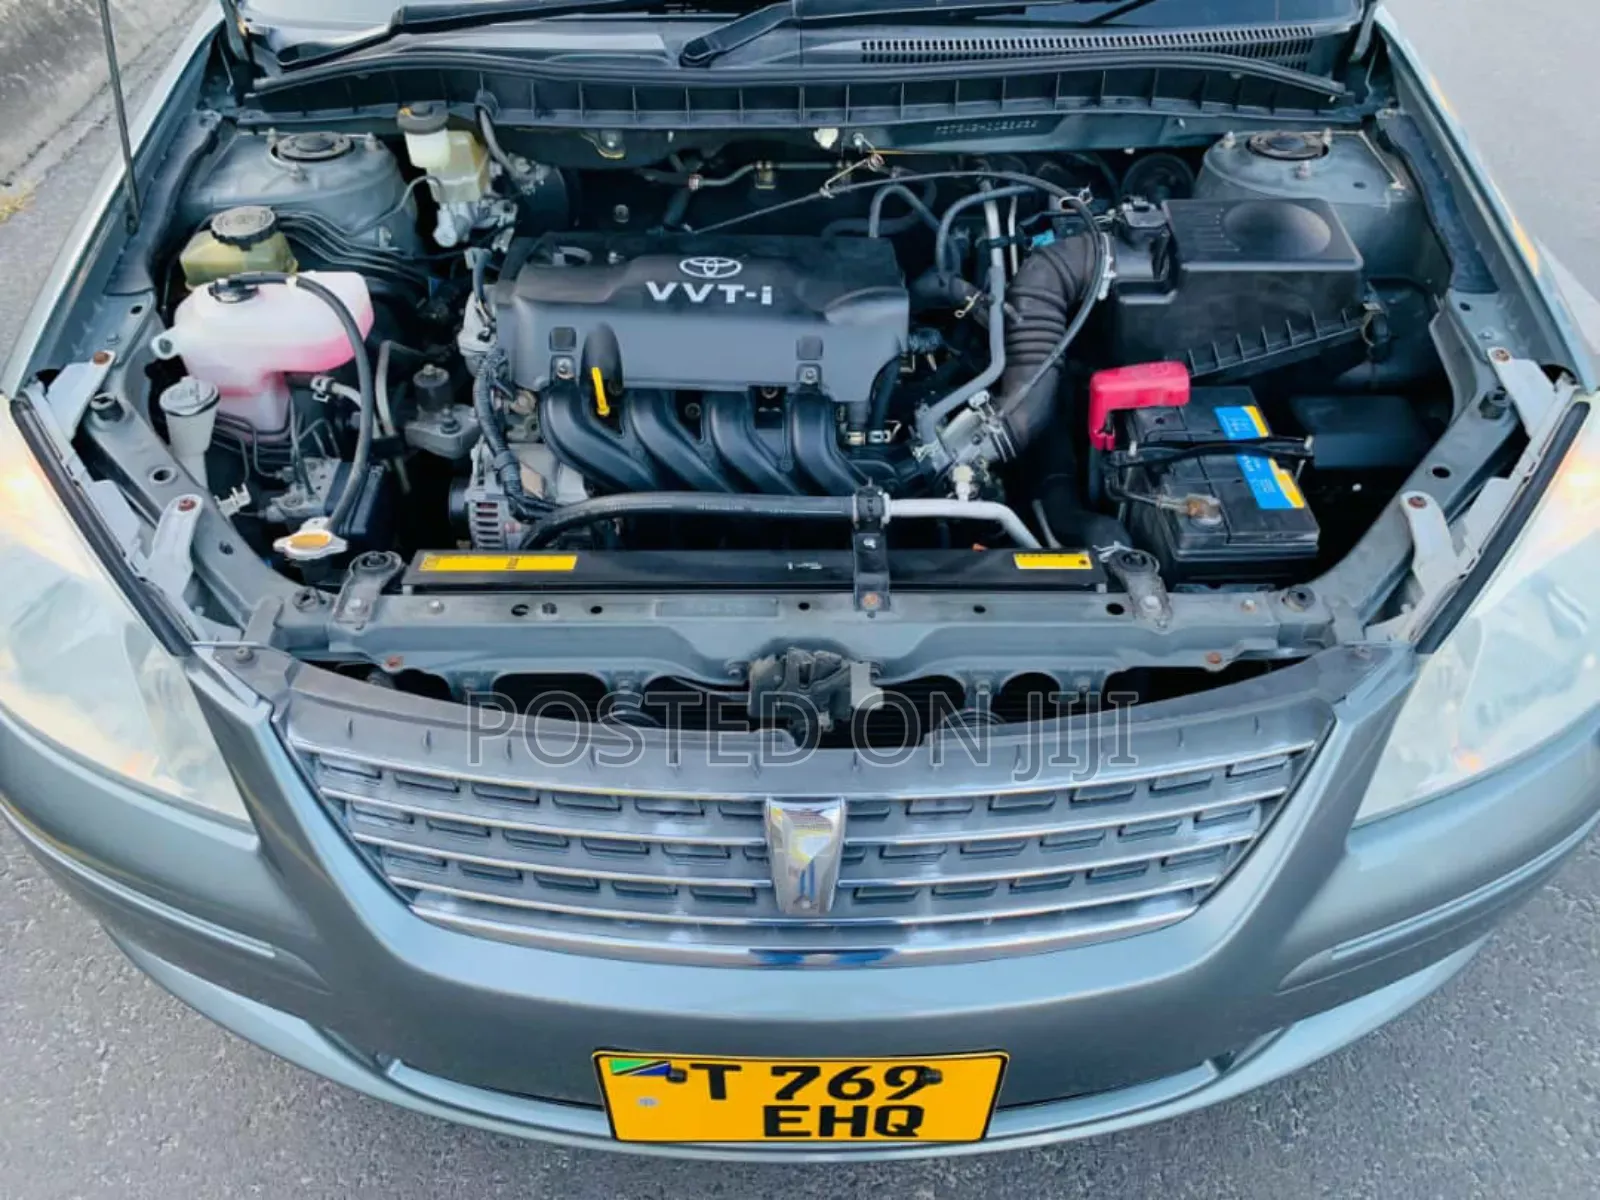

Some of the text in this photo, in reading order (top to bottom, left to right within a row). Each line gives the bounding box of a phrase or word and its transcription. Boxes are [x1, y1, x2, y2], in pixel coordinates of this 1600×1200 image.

[645, 282, 773, 305] VVT-i
[690, 1063, 930, 1101] T 769
[762, 1105, 925, 1138] EHQ
